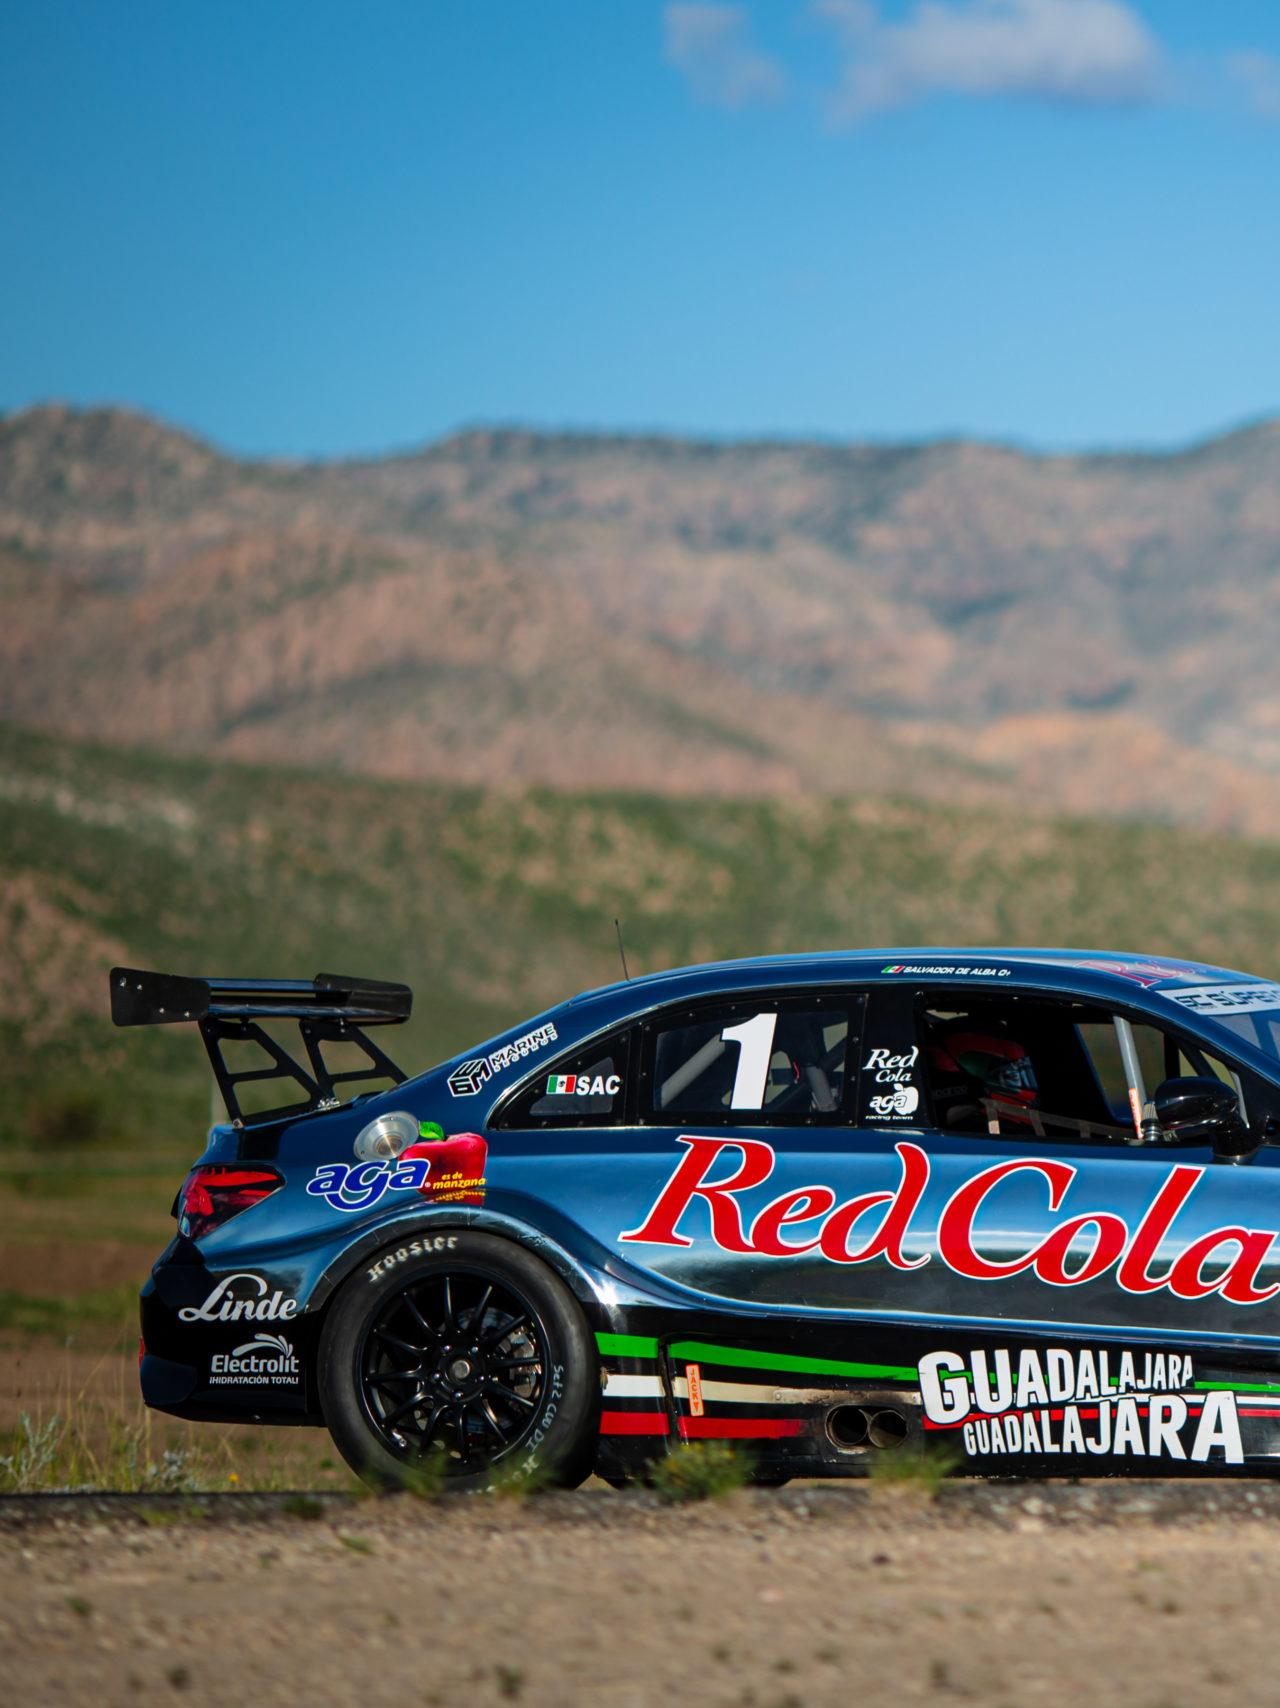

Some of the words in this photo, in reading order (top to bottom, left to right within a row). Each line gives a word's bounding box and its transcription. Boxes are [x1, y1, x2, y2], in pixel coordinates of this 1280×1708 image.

[903, 966, 953, 974] SALVADOR
[955, 967, 971, 975] DE
[970, 968, 996, 976] ALBA
[490, 1024, 555, 1066] MARINE
[722, 1013, 777, 1110] 1
[862, 1046, 919, 1070] Red
[576, 1075, 621, 1096] SAC
[875, 1069, 912, 1082] Cola
[869, 1094, 907, 1115] aga
[306, 1158, 431, 1212] aga
[432, 1178, 487, 1190] manzana
[452, 1172, 463, 1180] de
[617, 1134, 933, 1271] Red
[178, 1273, 297, 1321] Linde
[211, 1354, 299, 1373] Electrolit
[917, 1348, 1194, 1425] GUADALAJARA
[963, 1390, 1245, 1465] GUADALAJARA
